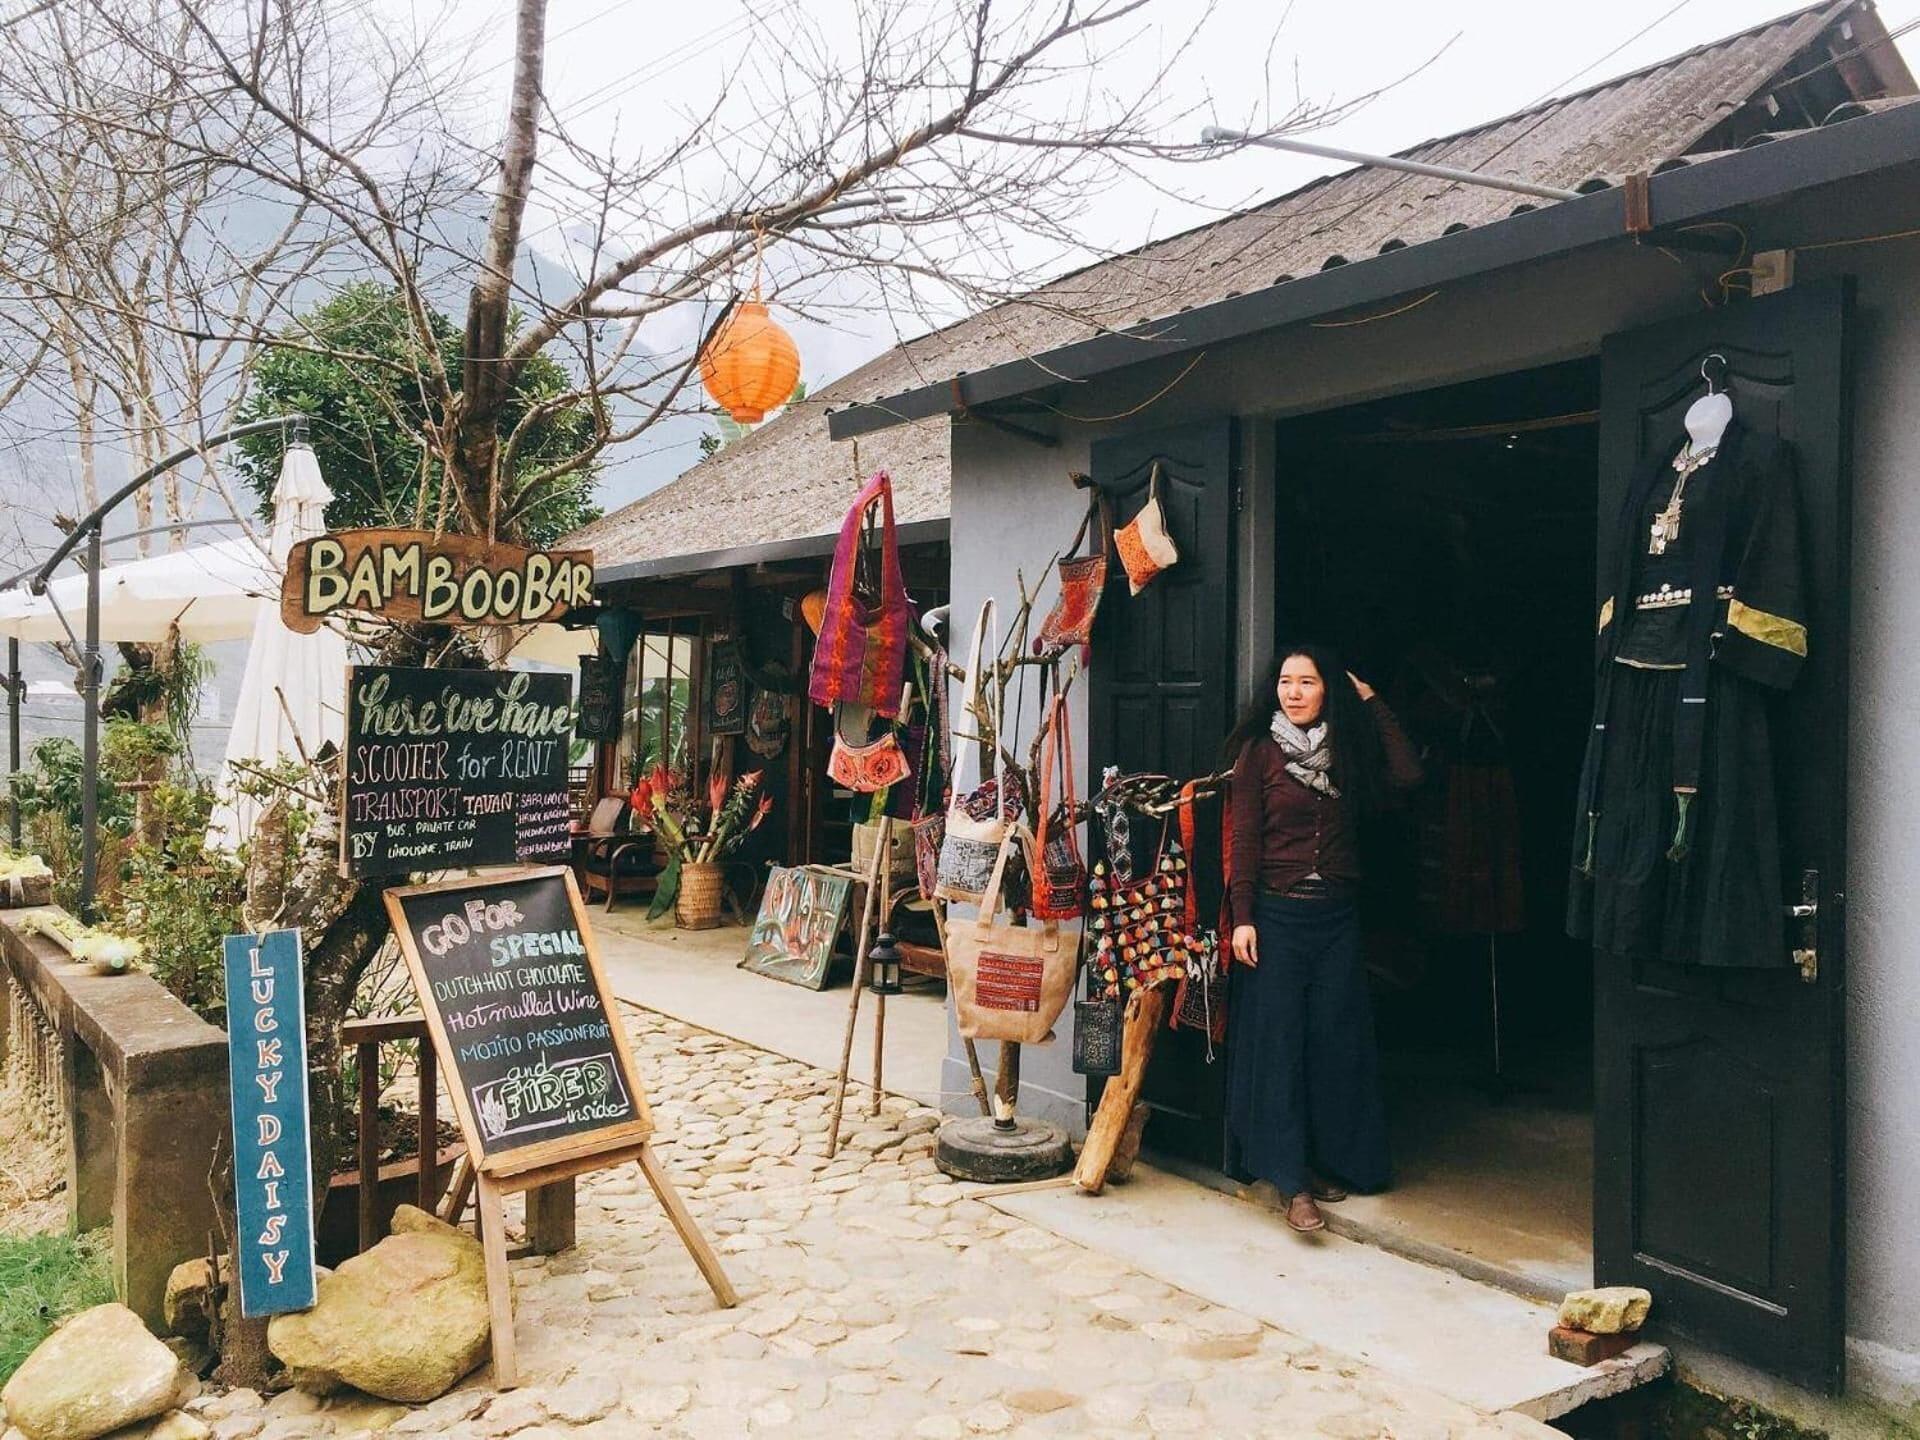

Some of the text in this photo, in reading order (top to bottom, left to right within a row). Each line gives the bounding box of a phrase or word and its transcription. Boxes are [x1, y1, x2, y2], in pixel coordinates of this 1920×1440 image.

[359, 673, 442, 736] here
[496, 673, 573, 737] have
[352, 739, 558, 784] SCOOTER for RENT
[352, 787, 461, 821] TRANSPORT
[416, 820, 457, 834] PRIVATE
[458, 819, 477, 830] CAR
[351, 831, 379, 859] BY
[445, 837, 474, 852] TRAIN
[422, 900, 526, 955] GO FOR
[490, 930, 586, 967] SPECIAL
[517, 964, 586, 987] CHOCOLATE
[447, 989, 600, 1033] Hot mulled Wine
[507, 1051, 551, 1080] and
[249, 948, 289, 1284] LUCKY DAISY
[566, 1094, 630, 1123] inside
